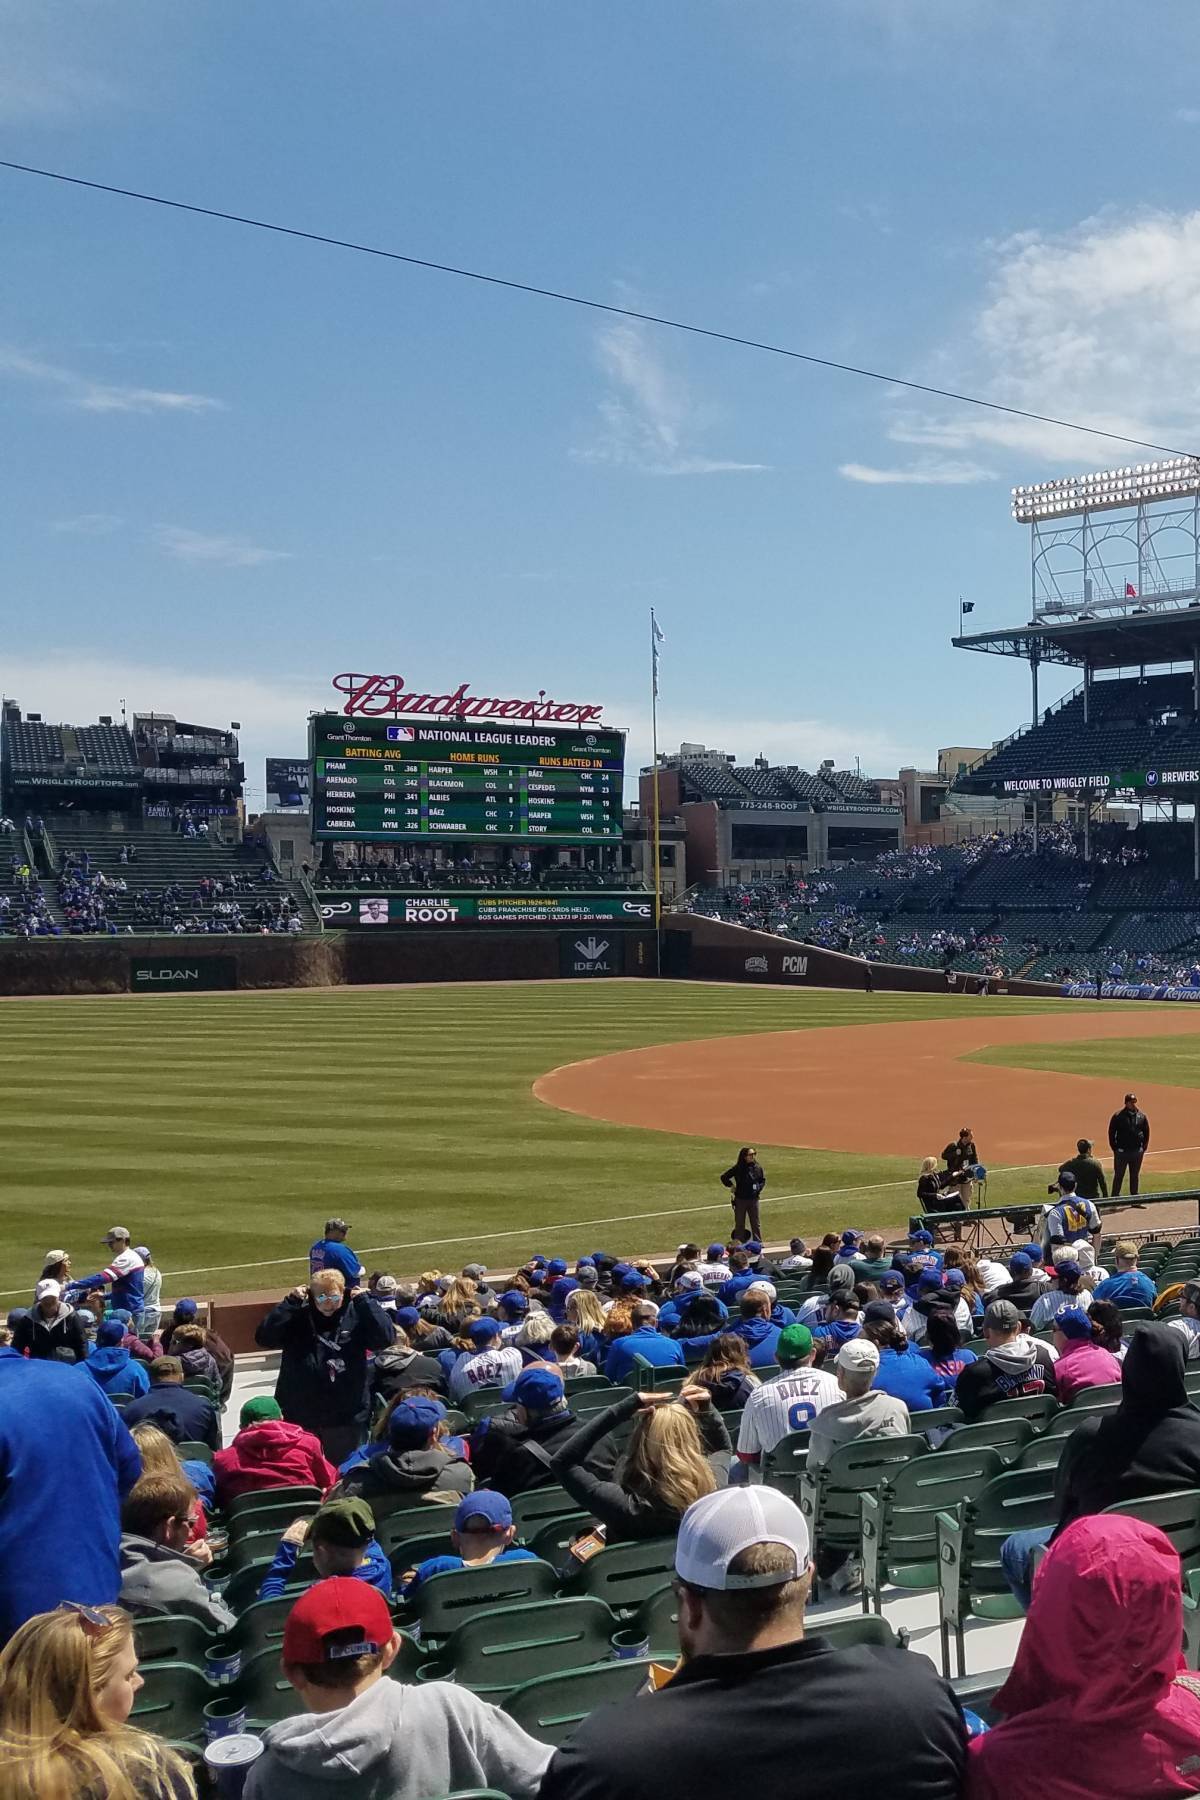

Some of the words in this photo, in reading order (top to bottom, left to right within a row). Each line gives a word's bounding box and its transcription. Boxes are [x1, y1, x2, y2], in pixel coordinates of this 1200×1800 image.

[332, 673, 603, 723] Budweiser
[419, 730, 472, 742] NATIONAL
[475, 733, 511, 743] LEAGUE
[515, 735, 556, 746] LEADERS
[345, 748, 381, 757] BATTING
[384, 750, 401, 758] AVG
[450, 753, 475, 761] HOME
[477, 754, 500, 763] RUNS
[540, 757, 560, 766] RUNS
[563, 758, 591, 767] BATTED
[594, 760, 602, 768] IN
[1162, 771, 1199, 782] BREWERS
[1004, 780, 1040, 791] WELCOME
[1042, 779, 1051, 789] TO
[1054, 777, 1087, 788] WRIGLEY
[1089, 776, 1110, 786] FIELD
[406, 909, 459, 921] ROOT
[574, 962, 611, 970] IDEAL
[782, 956, 808, 972] PCM
[136, 969, 198, 980] SLOAN
[1068, 985, 1112, 997] Reynods
[1112, 985, 1140, 998] Wrap
[467, 1363, 502, 1383] BAEZ
[776, 1379, 820, 1400] BAEZ
